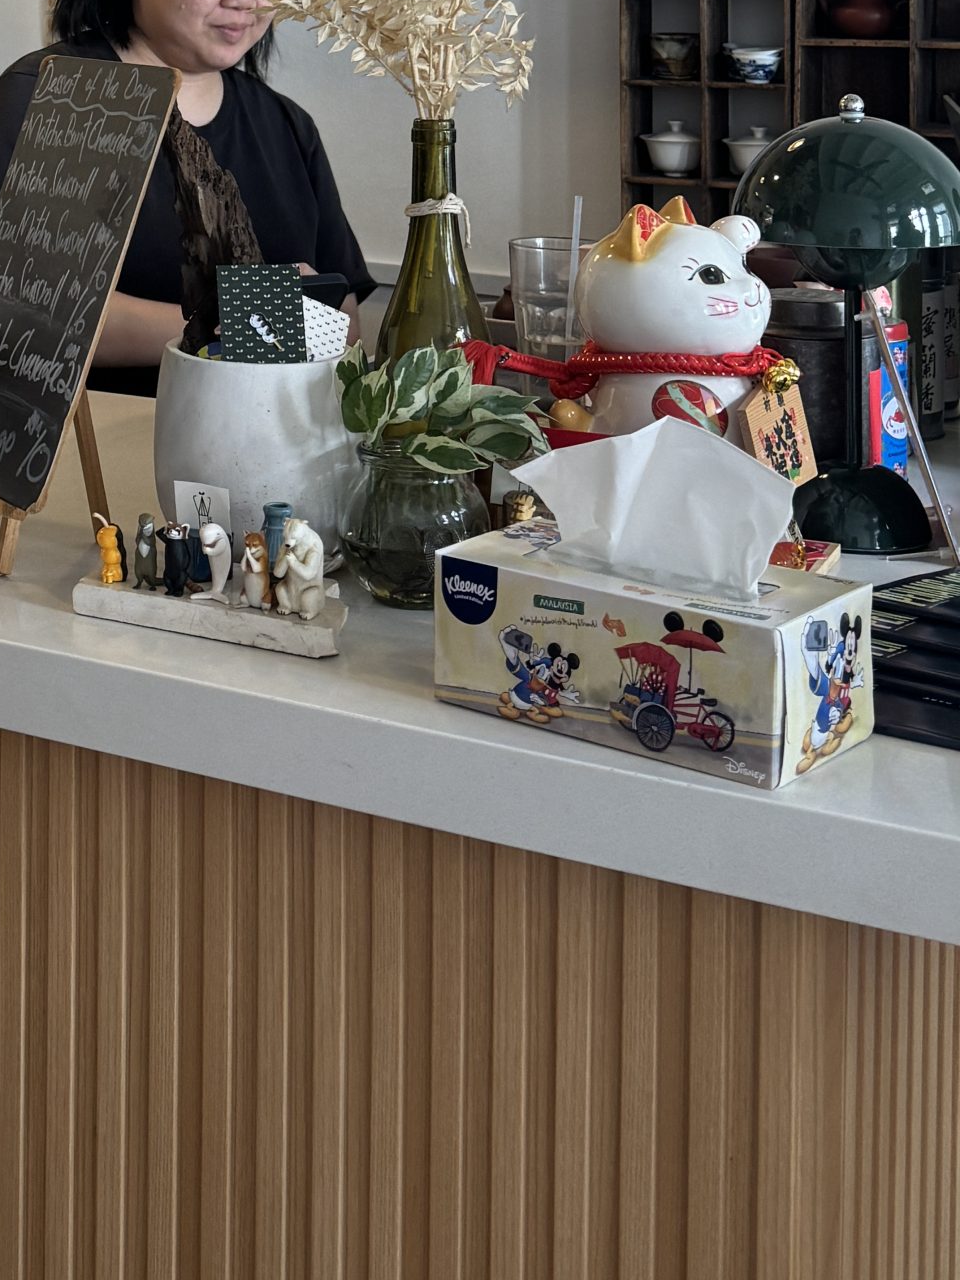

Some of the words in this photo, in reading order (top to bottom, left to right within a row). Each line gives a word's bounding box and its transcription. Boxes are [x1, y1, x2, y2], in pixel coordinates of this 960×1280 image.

[35, 60, 83, 100] Dessert
[85, 68, 102, 102] of
[100, 67, 120, 100] the
[124, 68, 157, 117] Day
[24, 109, 63, 150] Matcha
[445, 575, 495, 601] Kleenex
[540, 599, 578, 611] MALAYSIA
